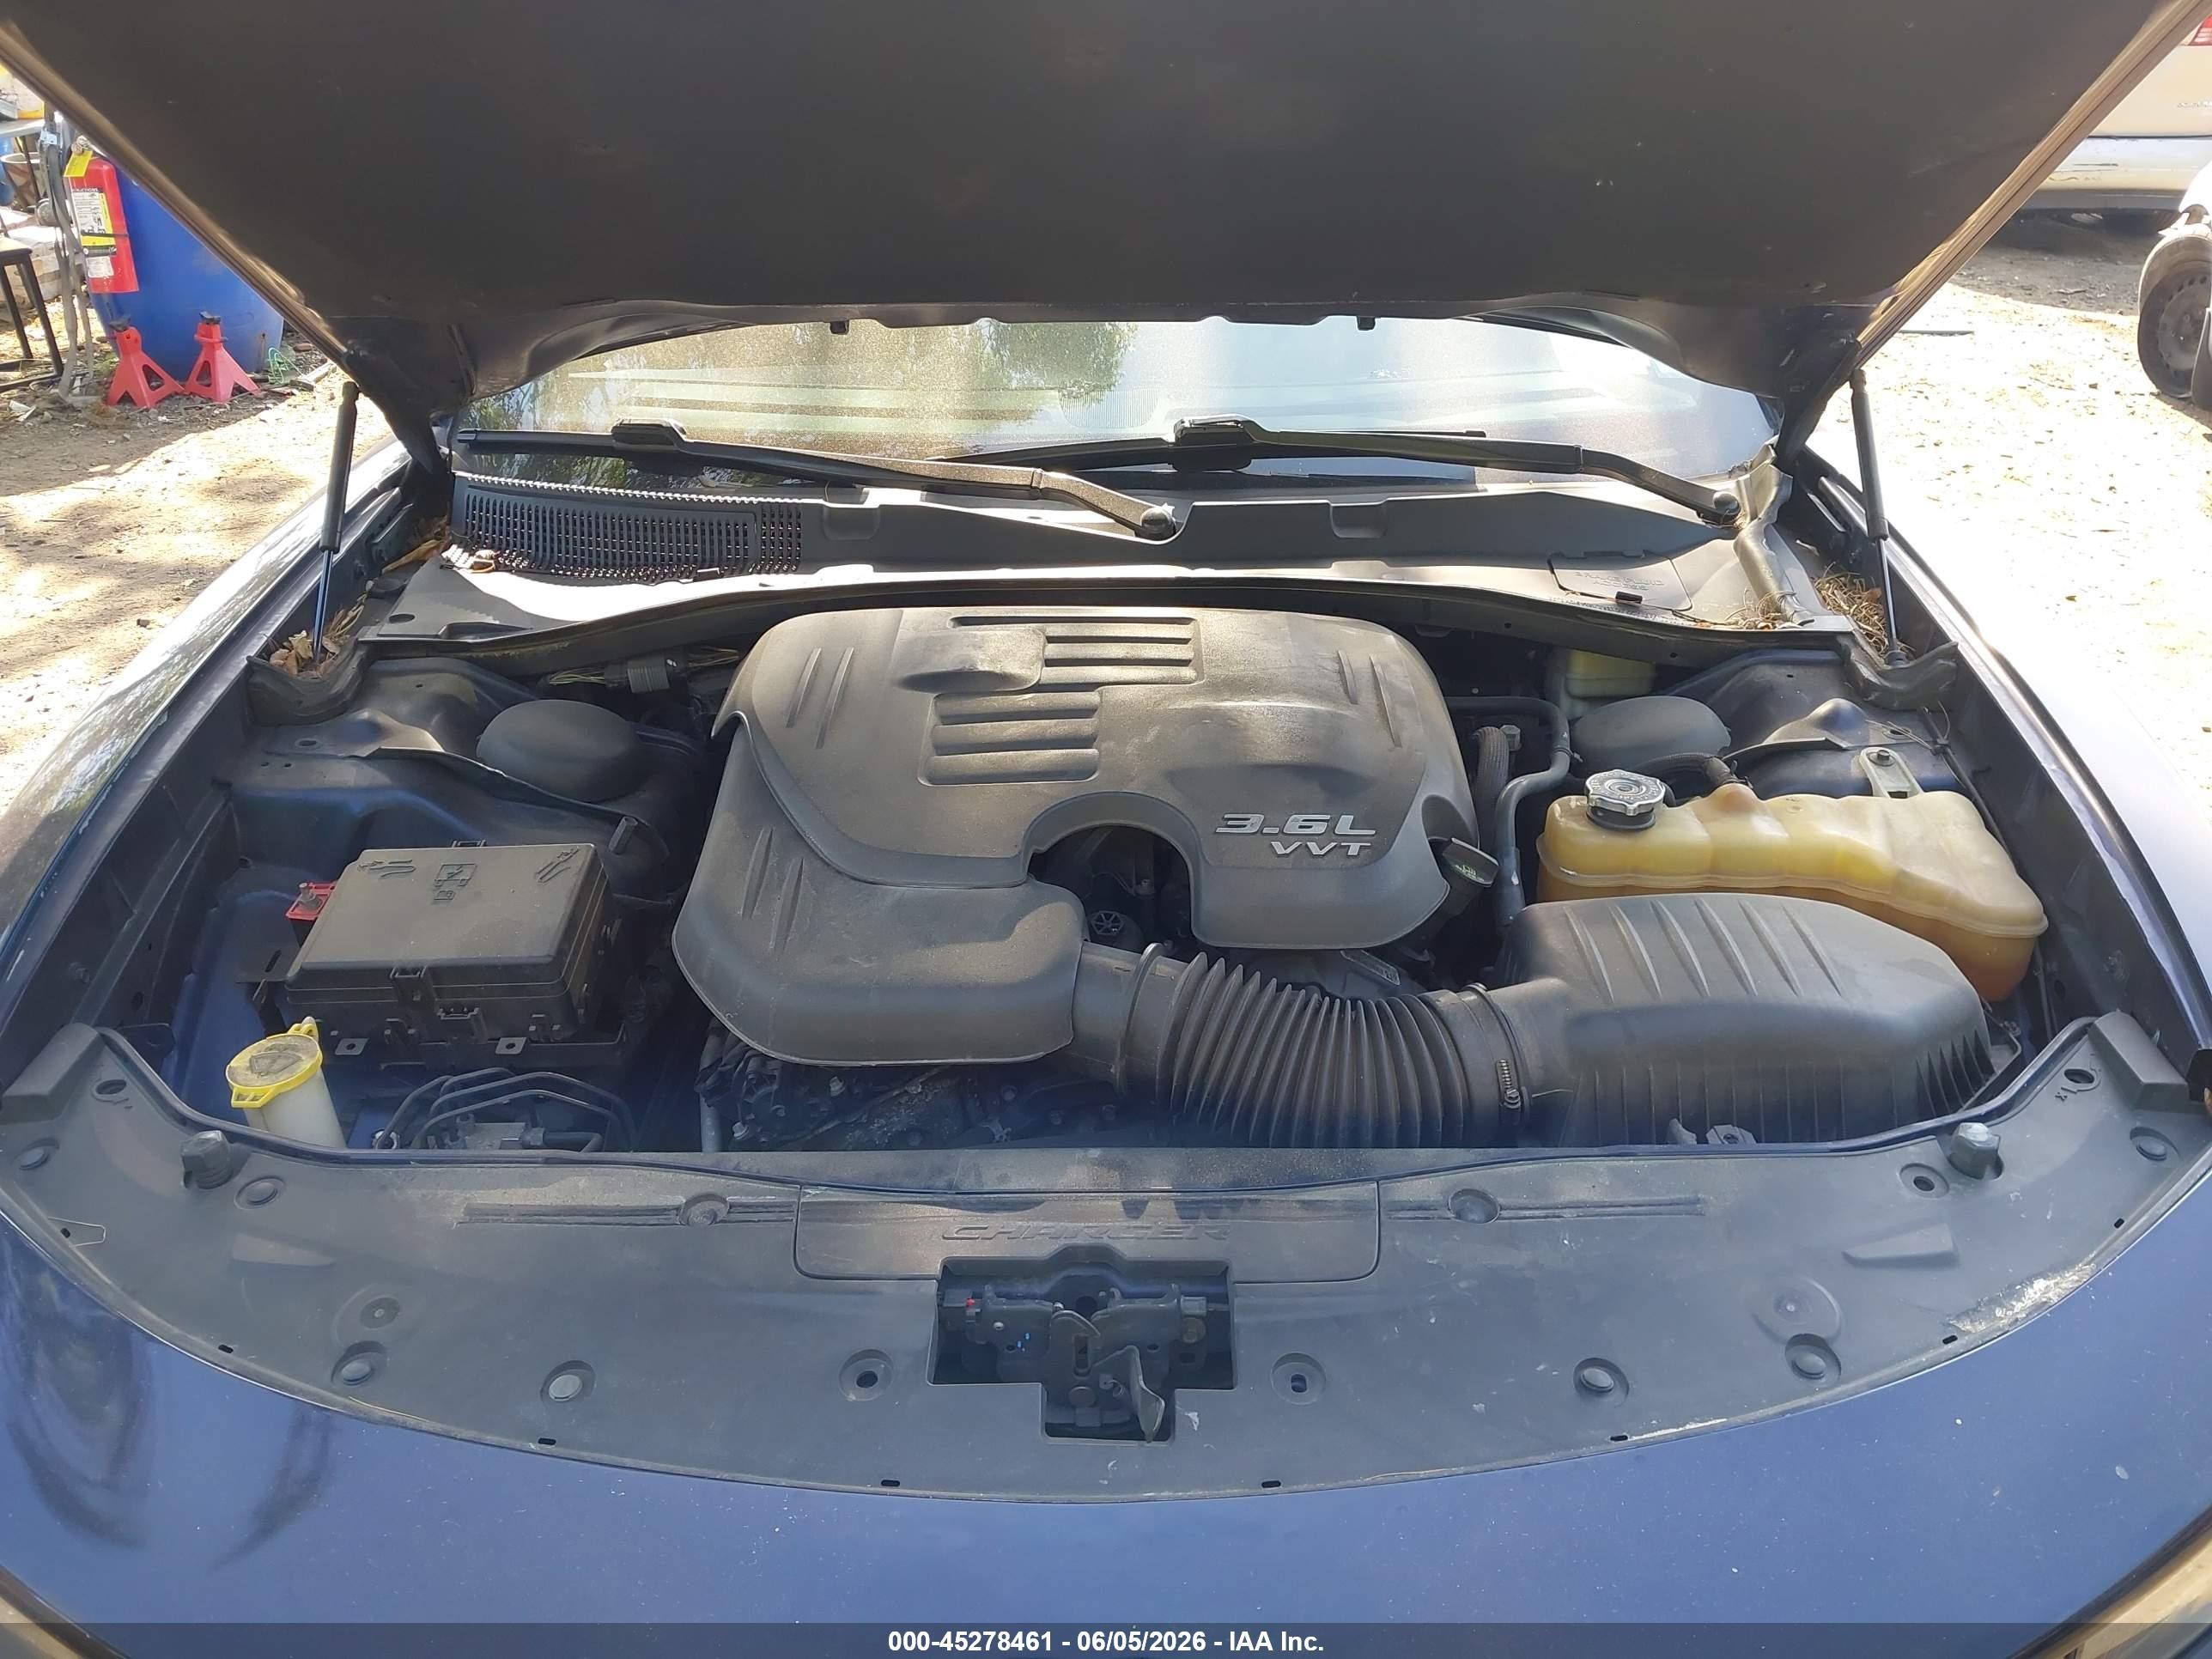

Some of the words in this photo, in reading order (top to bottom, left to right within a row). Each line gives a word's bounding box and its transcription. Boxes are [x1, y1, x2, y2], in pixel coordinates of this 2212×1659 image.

[1215, 813, 1376, 836] 3.6L
[1270, 841, 1372, 857] VVT
[941, 1224, 1231, 1241] CHARGER
